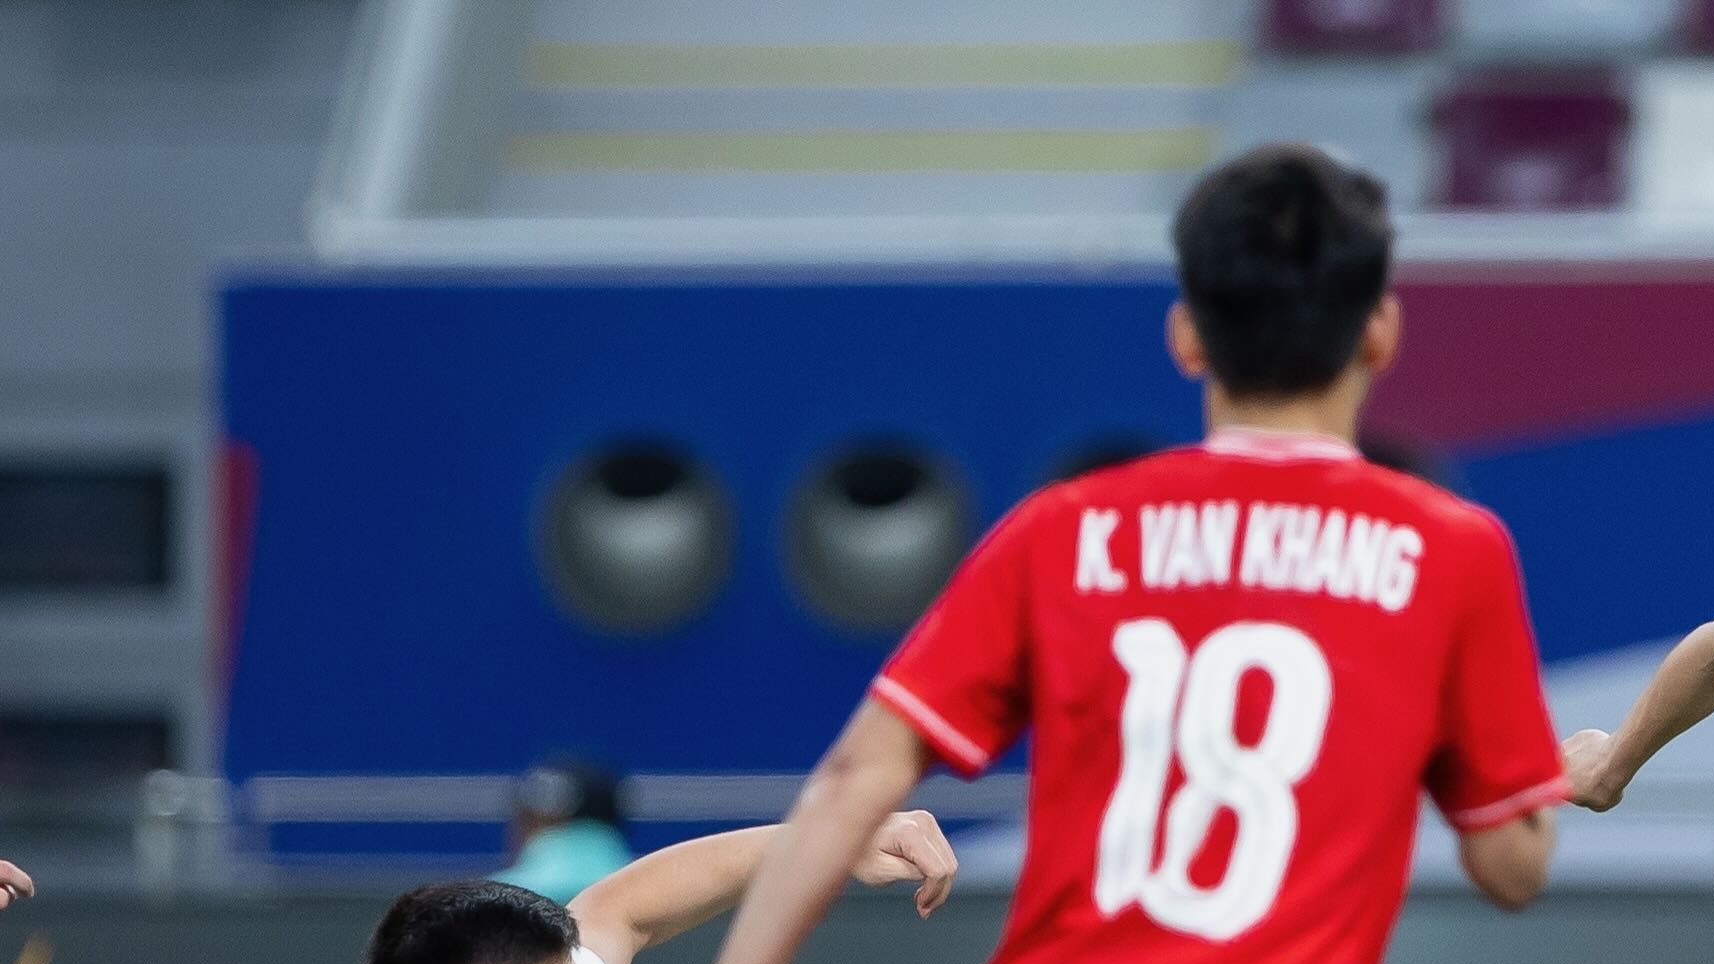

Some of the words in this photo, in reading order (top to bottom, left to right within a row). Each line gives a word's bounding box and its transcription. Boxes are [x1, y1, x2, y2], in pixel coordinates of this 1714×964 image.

[1075, 506, 1127, 592] K.
[1140, 500, 1240, 589] VAN
[1240, 502, 1424, 611] KHANG
[1094, 616, 1334, 942] 18
